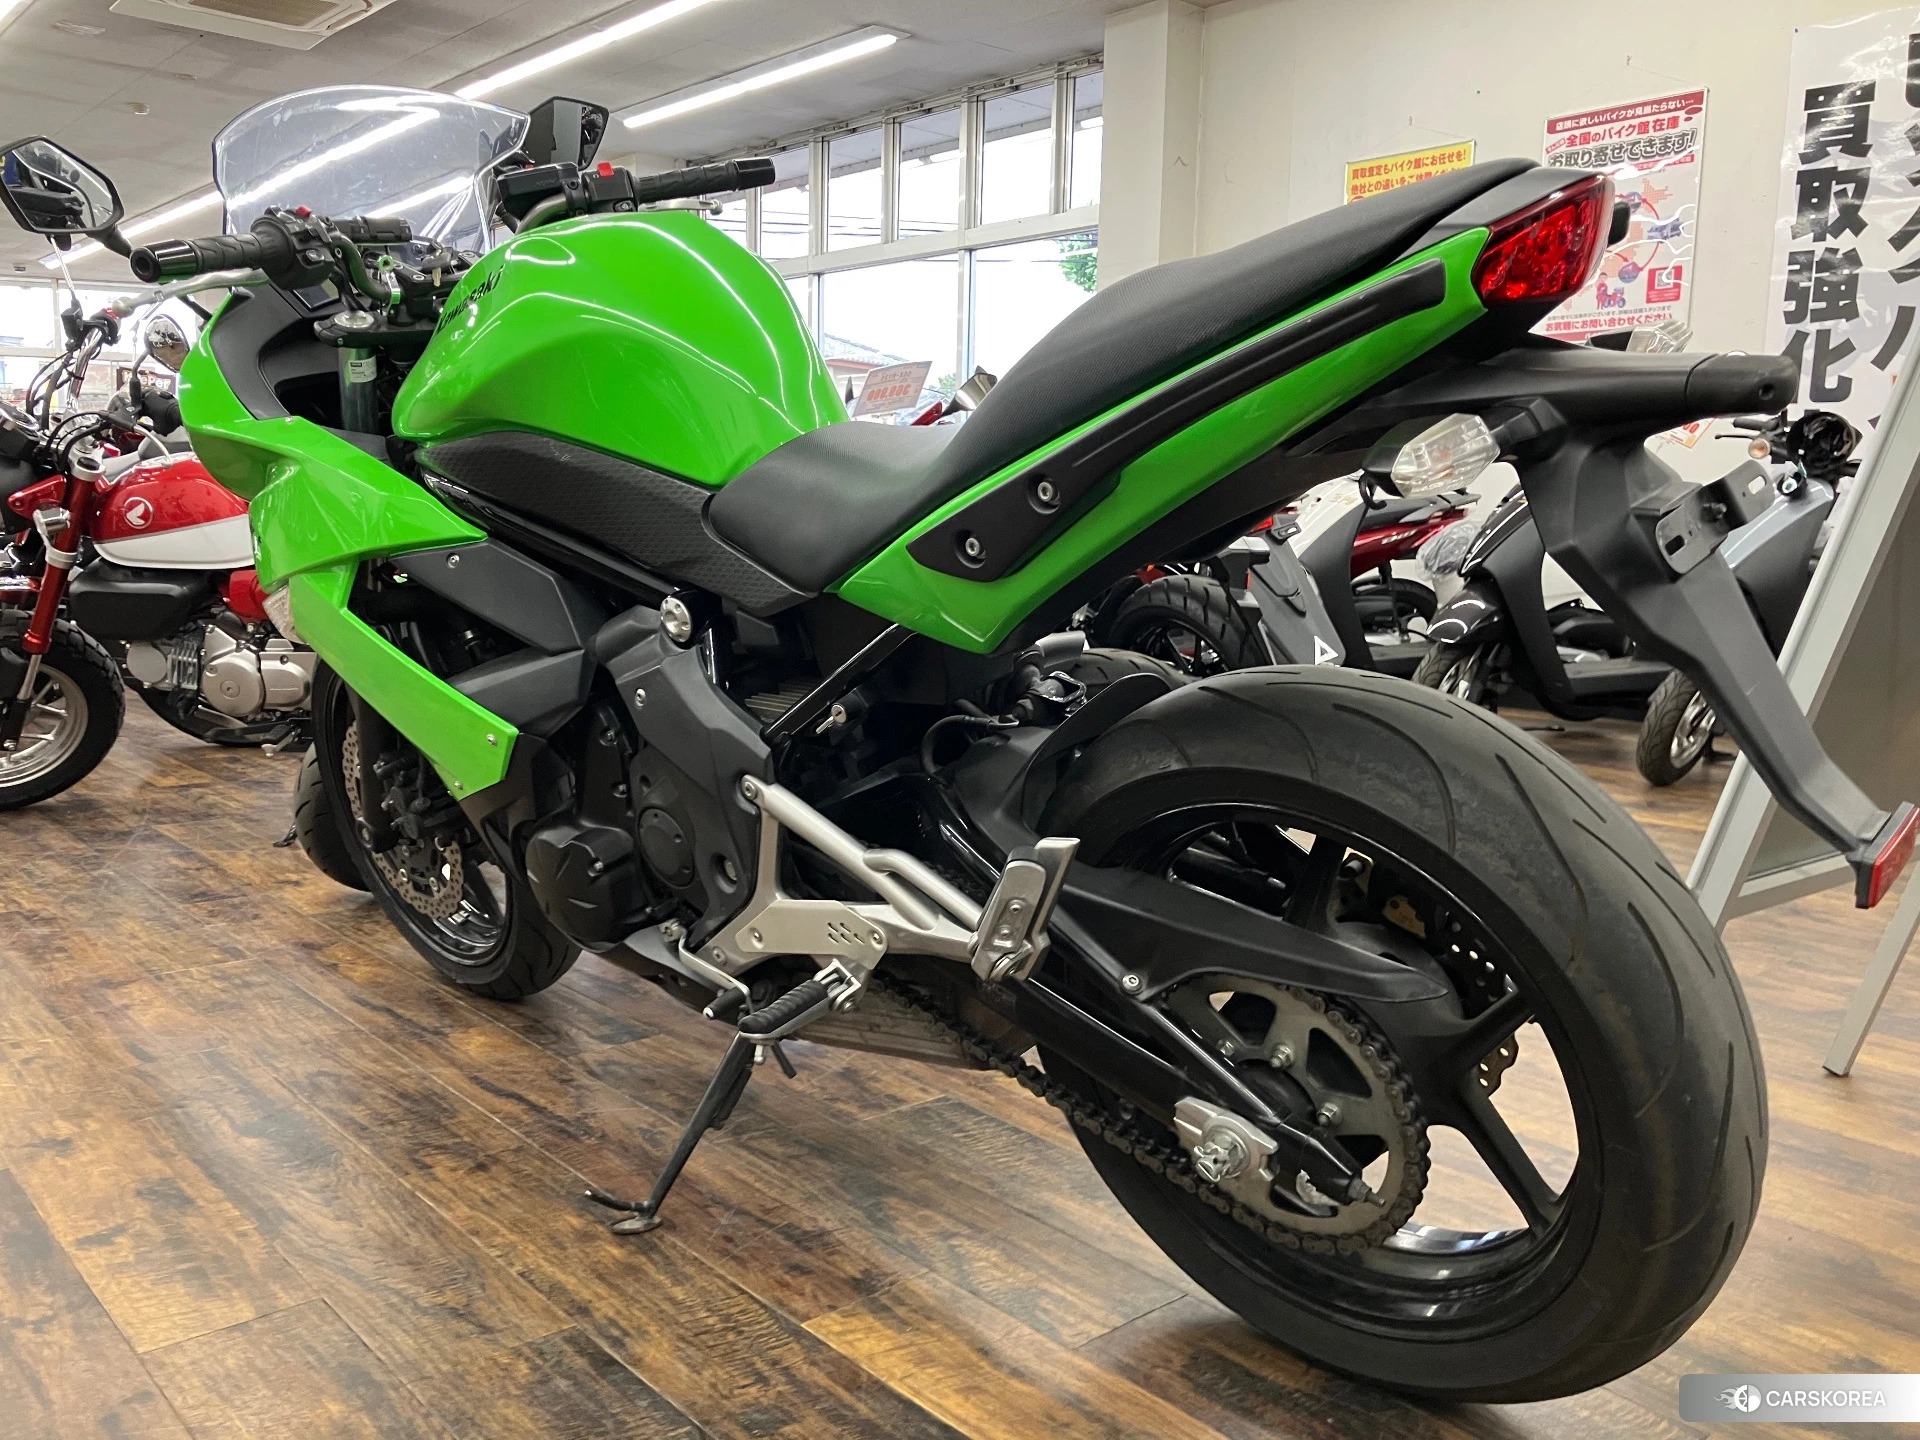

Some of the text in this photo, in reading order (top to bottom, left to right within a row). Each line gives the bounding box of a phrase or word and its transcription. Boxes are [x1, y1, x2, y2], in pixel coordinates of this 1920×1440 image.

[1781, 80, 1876, 403] 買取強化
[437, 263, 506, 333] Kawasaki
[122, 369, 172, 391] KePer
